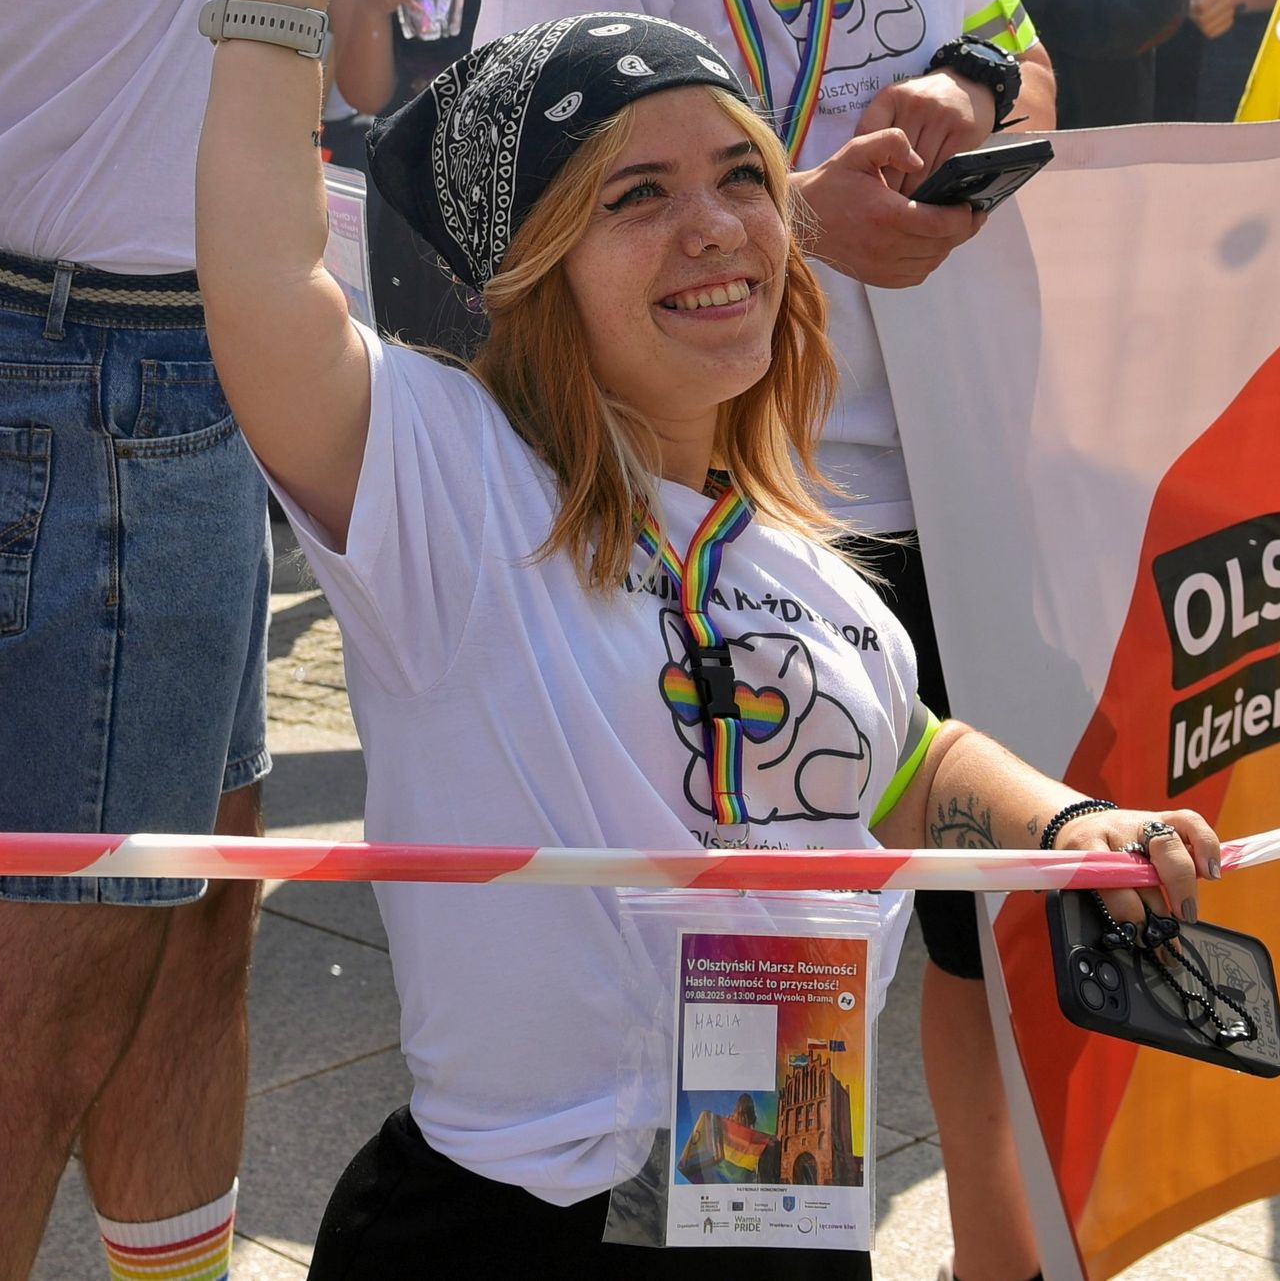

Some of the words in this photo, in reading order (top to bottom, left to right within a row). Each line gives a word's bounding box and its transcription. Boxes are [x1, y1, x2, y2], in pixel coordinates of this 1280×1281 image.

[818, 102, 848, 116] Marsz
[687, 958, 696, 971] V
[697, 958, 756, 974] Olsztyński
[758, 960, 795, 974] Marsz
[797, 961, 858, 976] Równości
[685, 976, 716, 988] Hasło:
[717, 975, 764, 989] Równość
[766, 979, 778, 989] to
[779, 978, 840, 992] przyszłość!
[685, 990, 726, 1000] 09.08.2025
[733, 991, 756, 1001] 13:00
[756, 992, 773, 1003] pod
[774, 993, 806, 1004] Wysoką
[807, 993, 834, 1005] Bramą
[734, 1215, 761, 1224] Warmia
[734, 1222, 761, 1233] PRIDE
